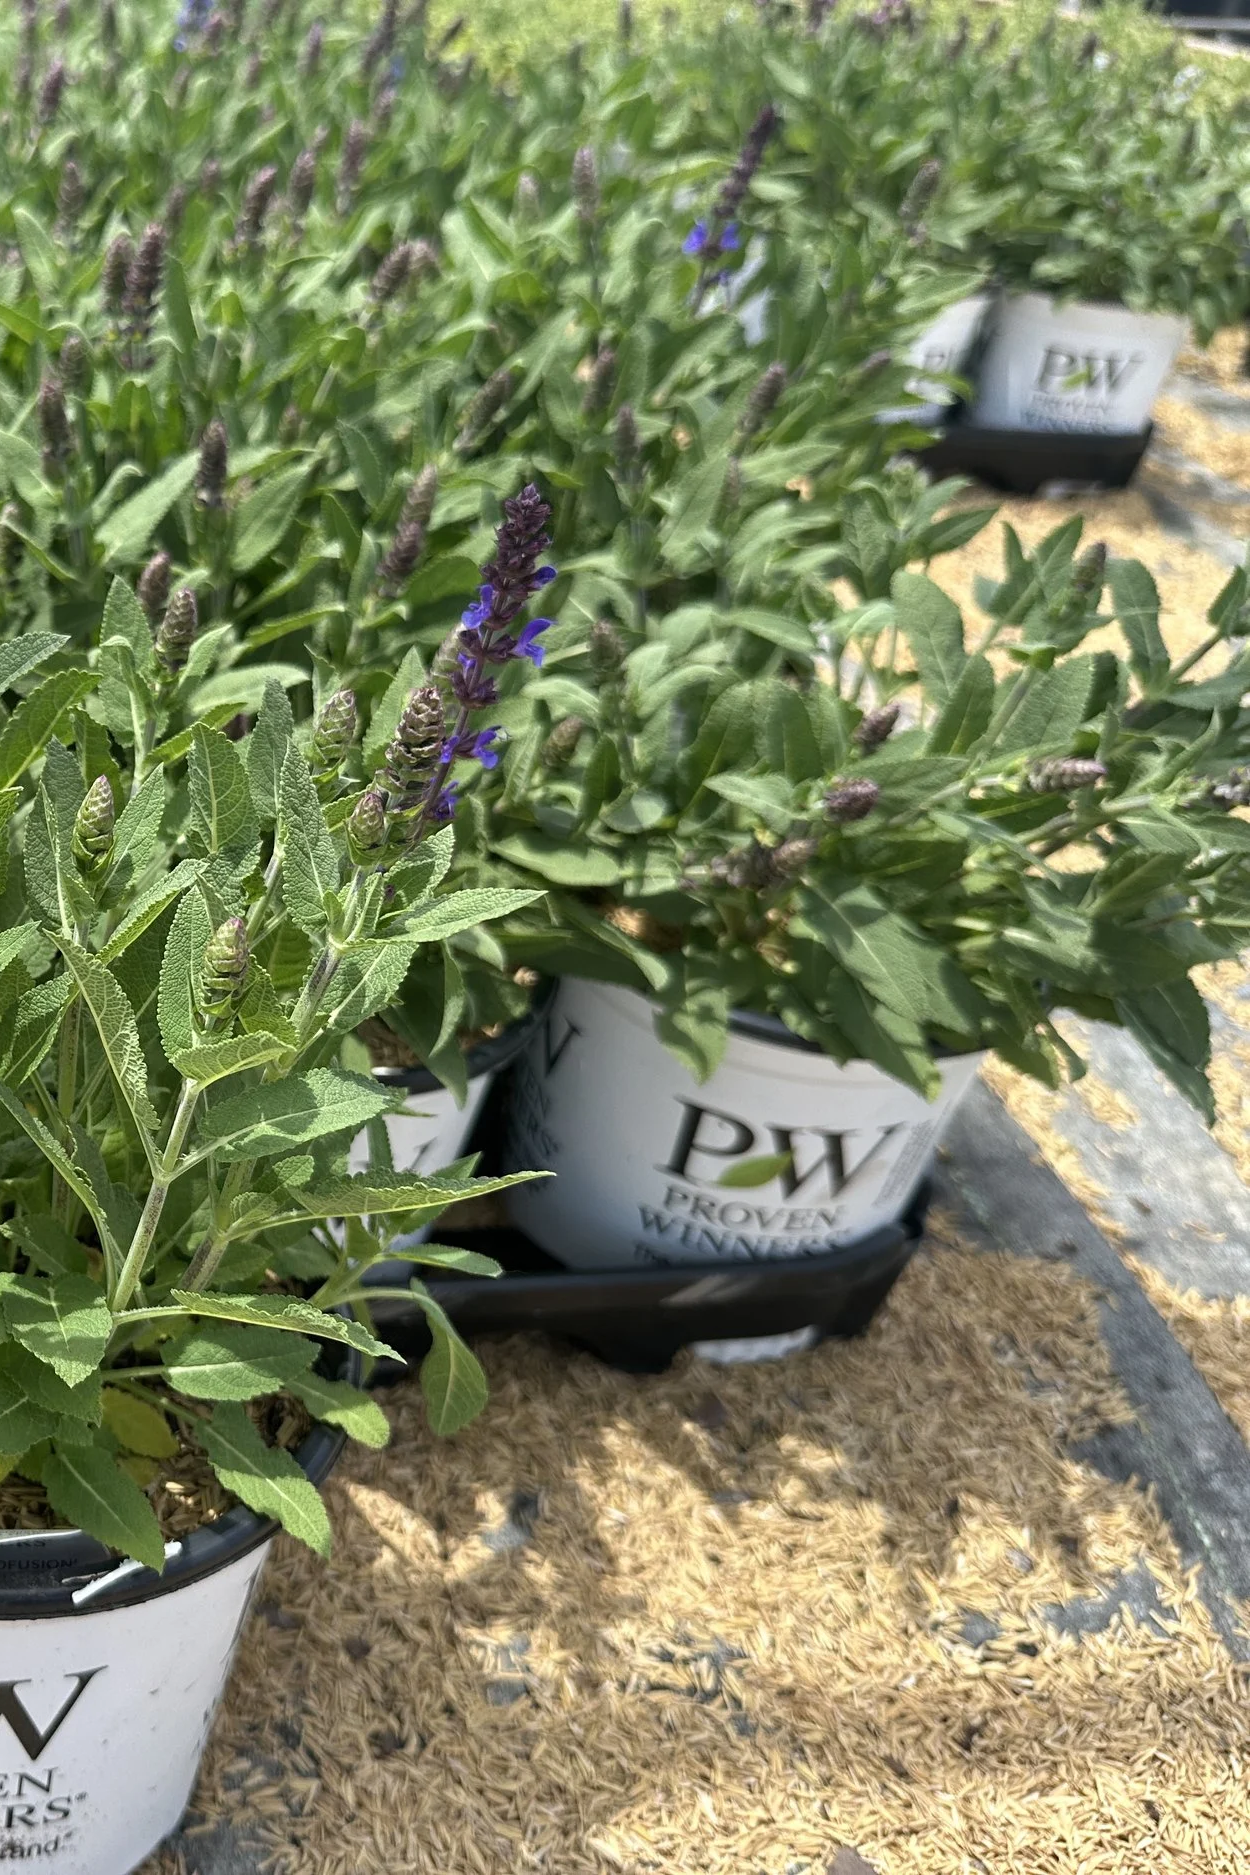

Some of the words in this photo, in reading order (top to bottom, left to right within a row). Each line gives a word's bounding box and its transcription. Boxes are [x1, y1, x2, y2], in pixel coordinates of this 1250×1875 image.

[1034, 344, 1145, 394] PW
[653, 1094, 908, 1202] PW
[664, 1184, 846, 1230] PROVEN
